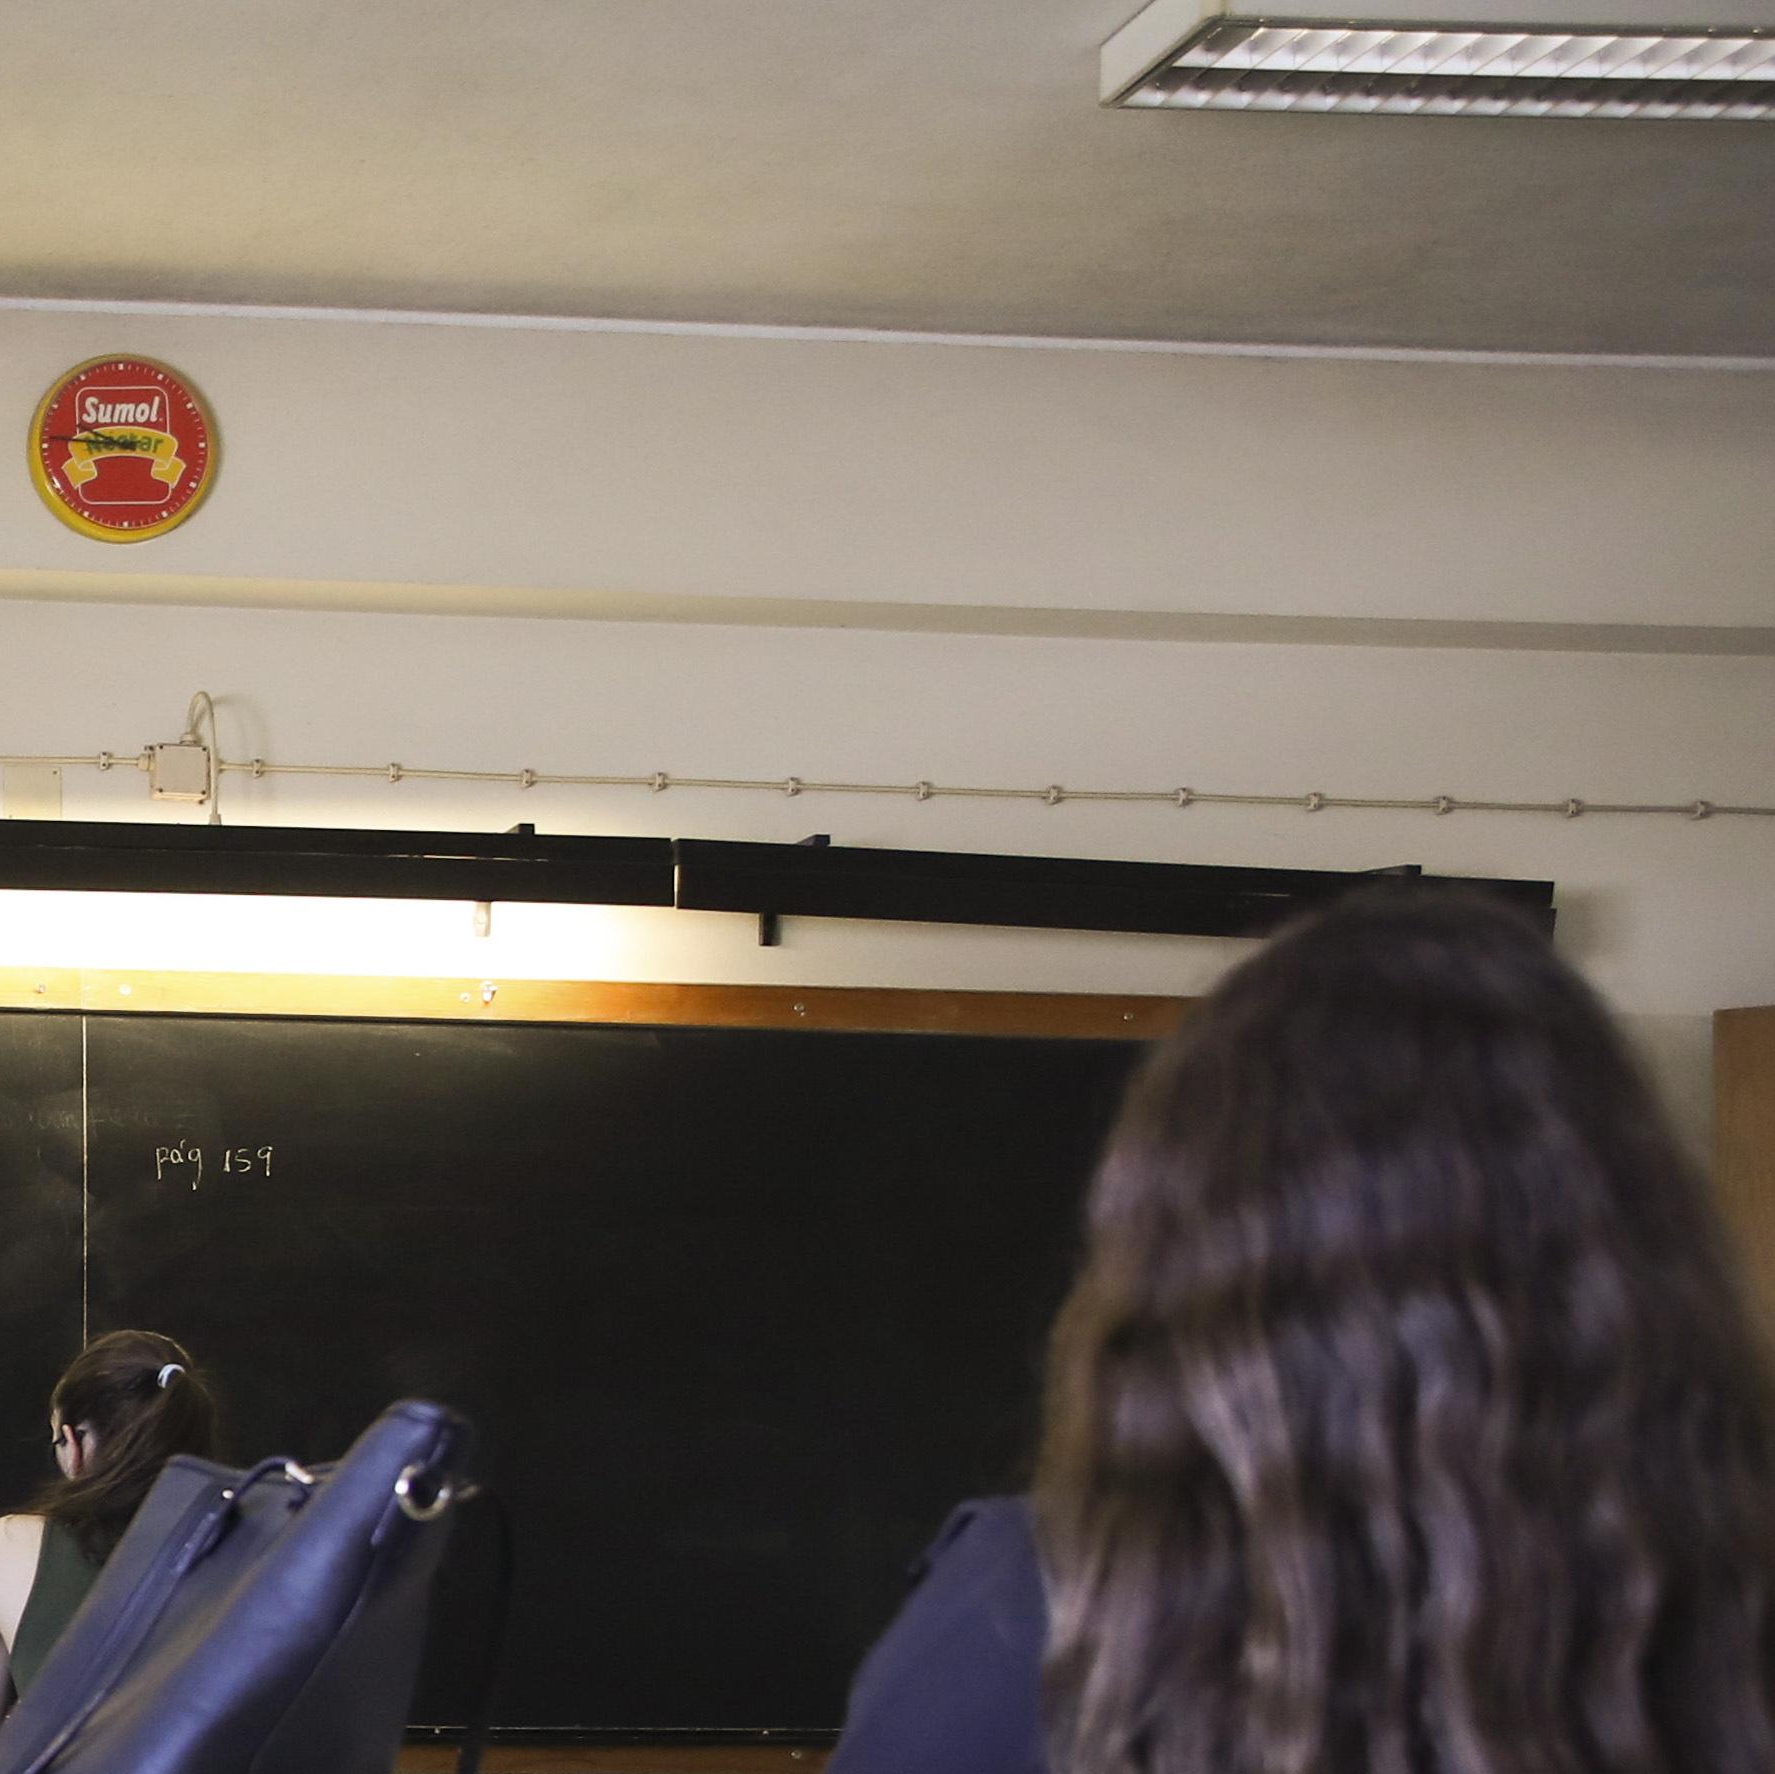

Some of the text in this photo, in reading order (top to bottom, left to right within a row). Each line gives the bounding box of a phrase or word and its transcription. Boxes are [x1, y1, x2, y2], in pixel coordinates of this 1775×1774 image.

[82, 396, 160, 424] Sumol
[156, 1138, 273, 1190] pág 159
